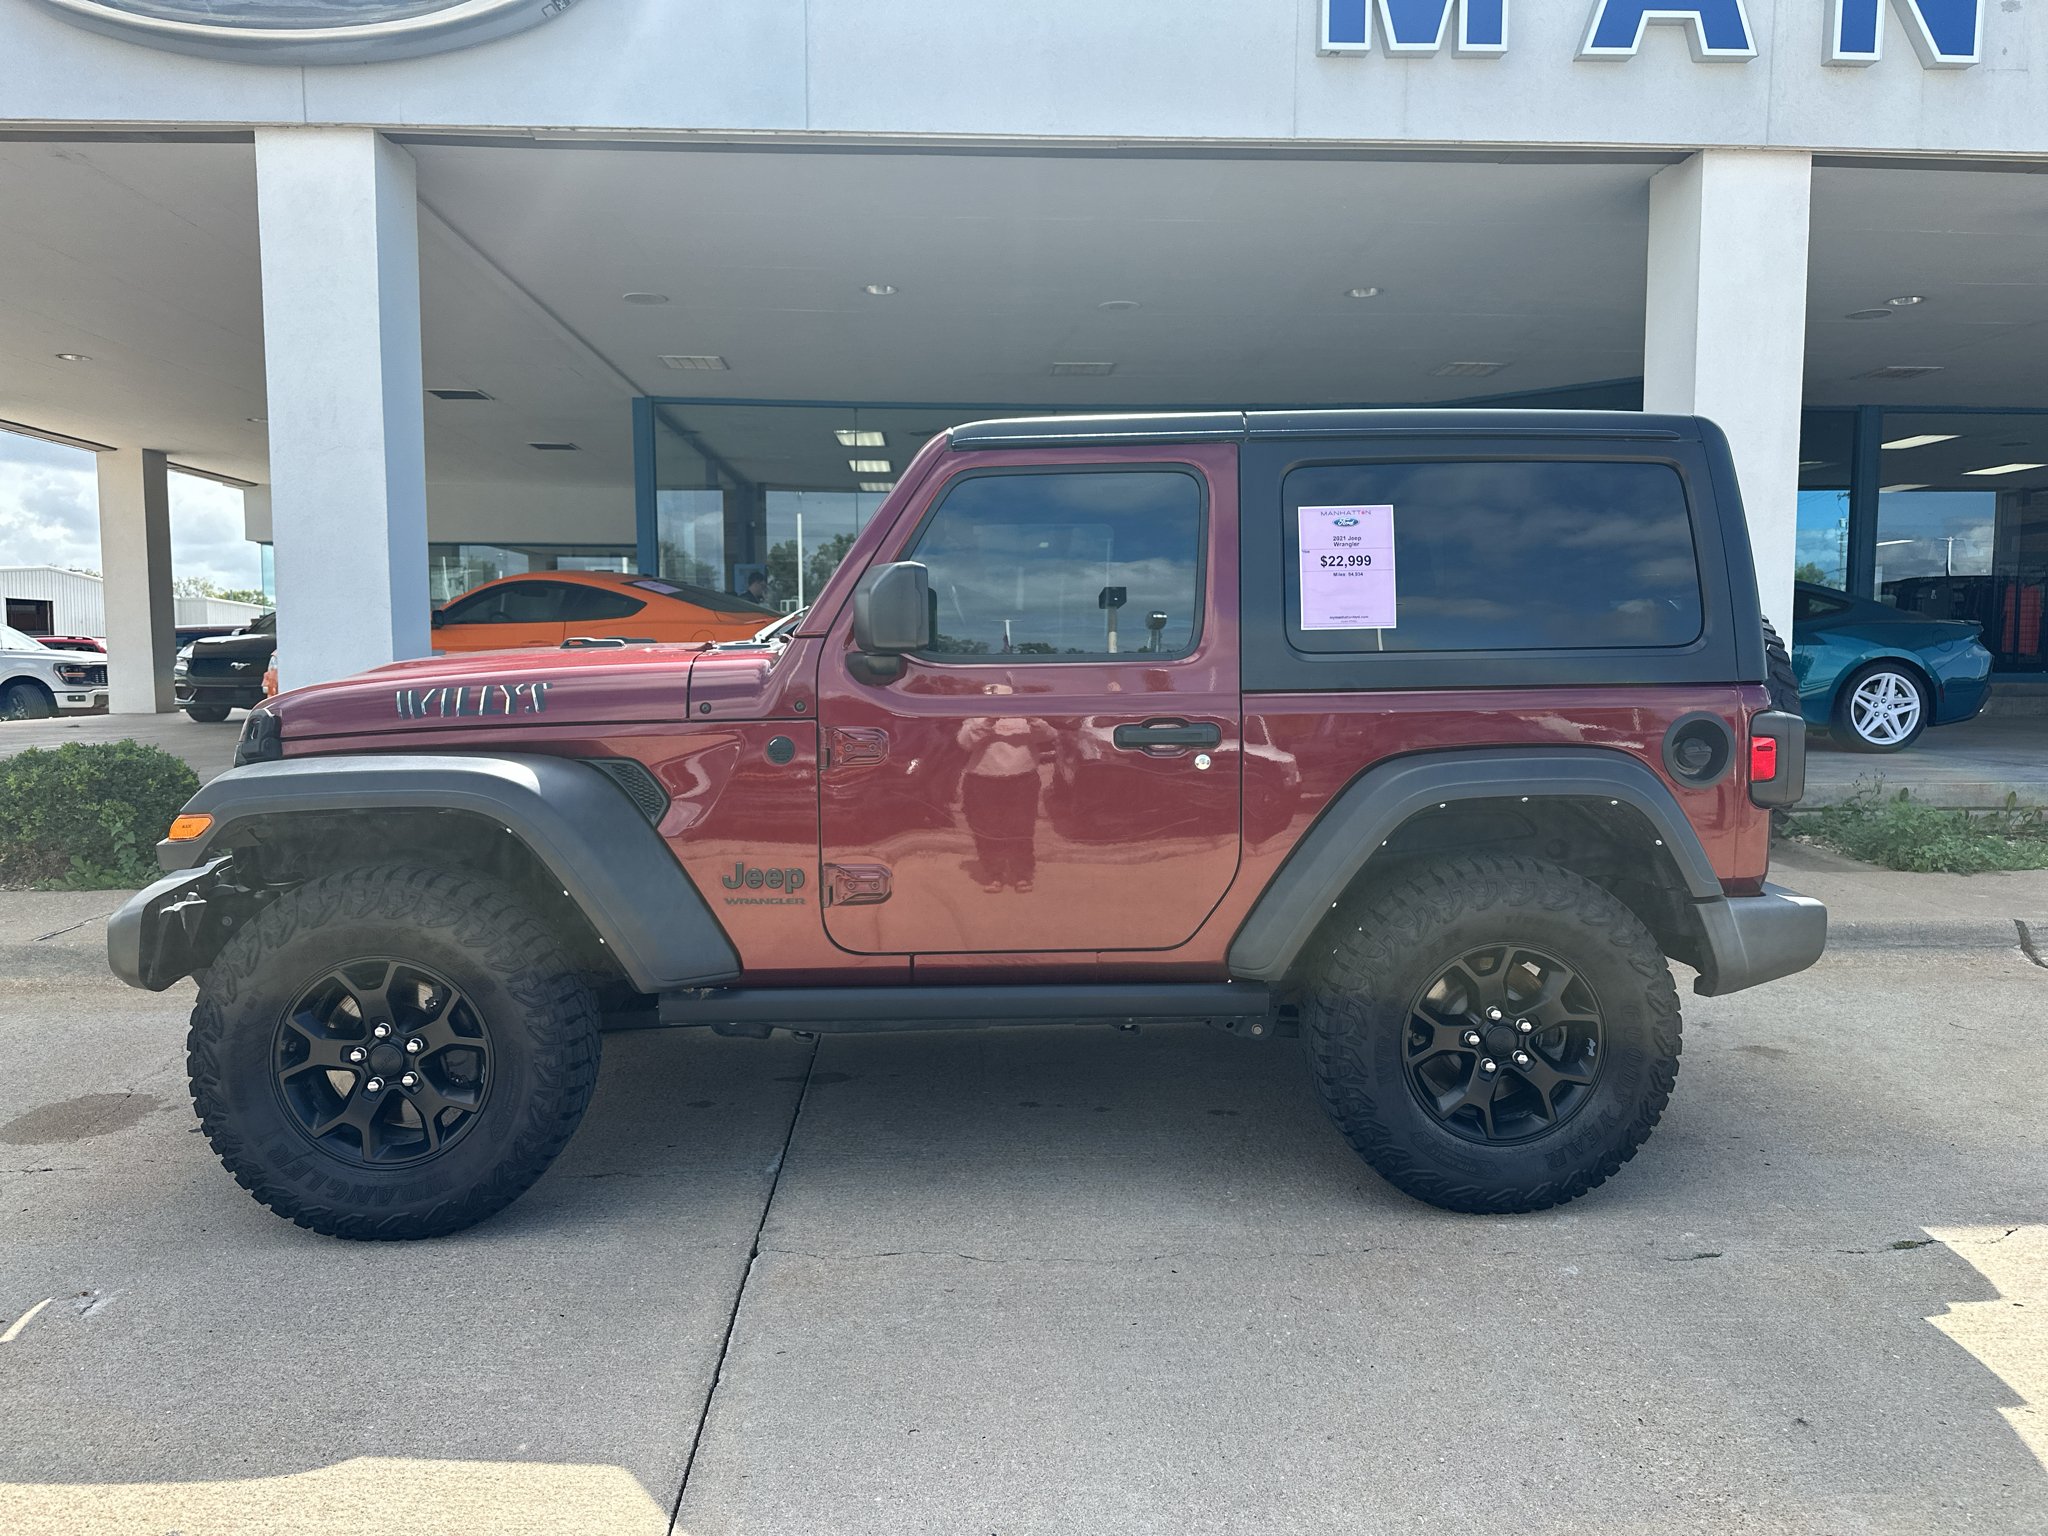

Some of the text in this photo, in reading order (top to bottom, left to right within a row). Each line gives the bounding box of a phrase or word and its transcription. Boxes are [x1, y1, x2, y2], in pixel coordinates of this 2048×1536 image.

[1320, 555, 1372, 568] $22,999
[722, 862, 805, 894] Jeep
[725, 897, 806, 905] WRANGLER
